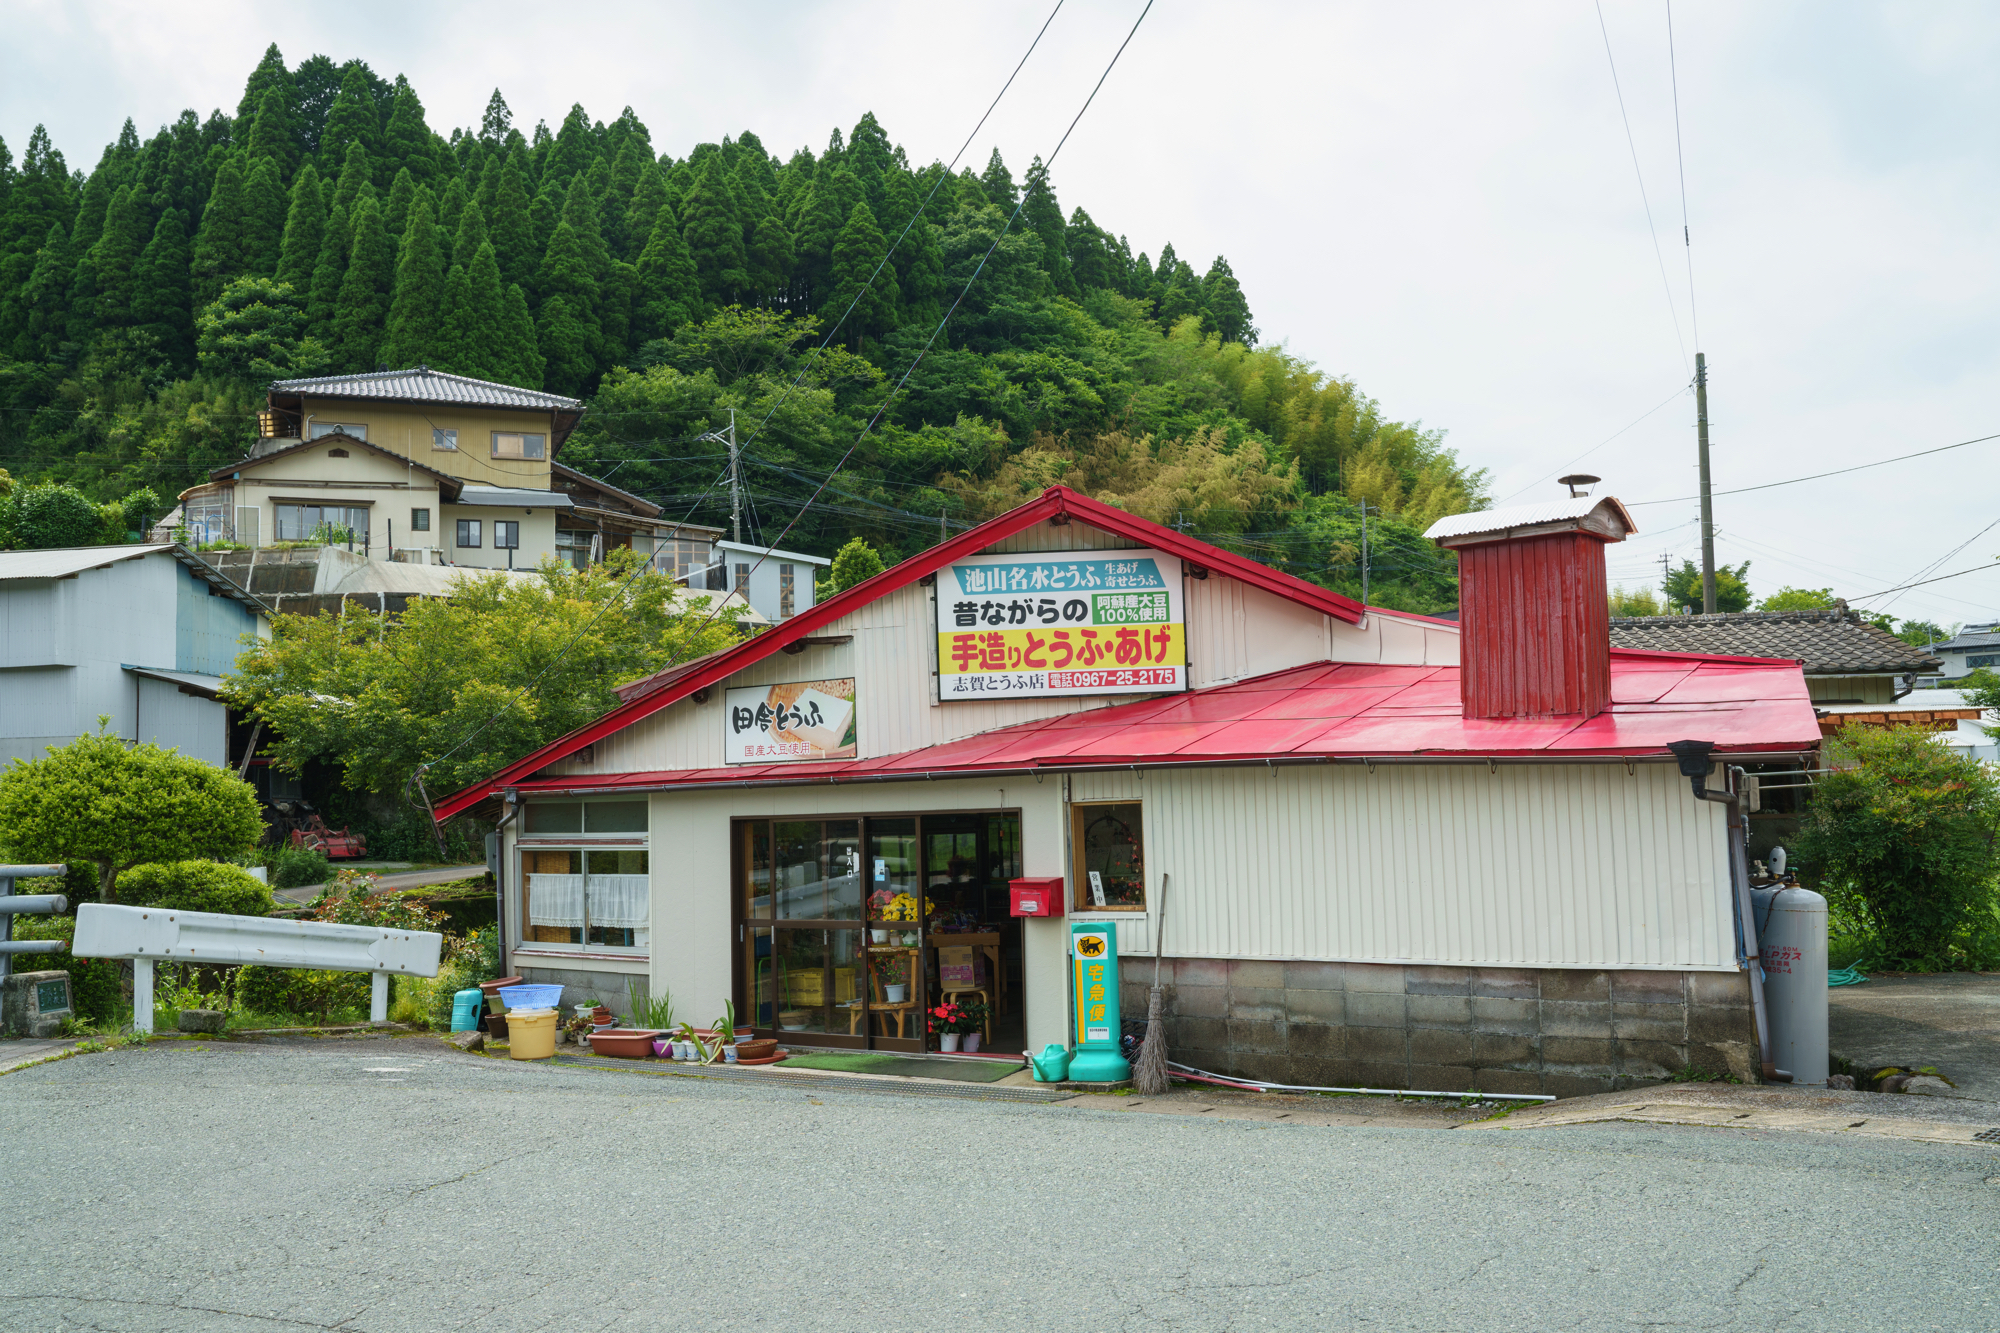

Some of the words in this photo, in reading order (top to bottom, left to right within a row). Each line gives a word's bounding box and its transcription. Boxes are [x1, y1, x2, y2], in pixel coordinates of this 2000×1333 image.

[1104, 561, 1139, 575] 生あげ
[965, 564, 1101, 593] 池山名水とうふ
[1104, 574, 1158, 588] 寄せとうふ
[1096, 593, 1167, 610] 阿蘇産大豆
[953, 598, 1089, 627] 昔ながらの
[1099, 608, 1167, 623] 100%使用
[951, 624, 1171, 672] 手造りとうふ・あげ
[952, 673, 1045, 692] 志賀とうふ店
[732, 700, 824, 735] 田舎とうふ
[744, 741, 811, 757] 国産大豆使用
[1087, 963, 1106, 1022] 宅急便
